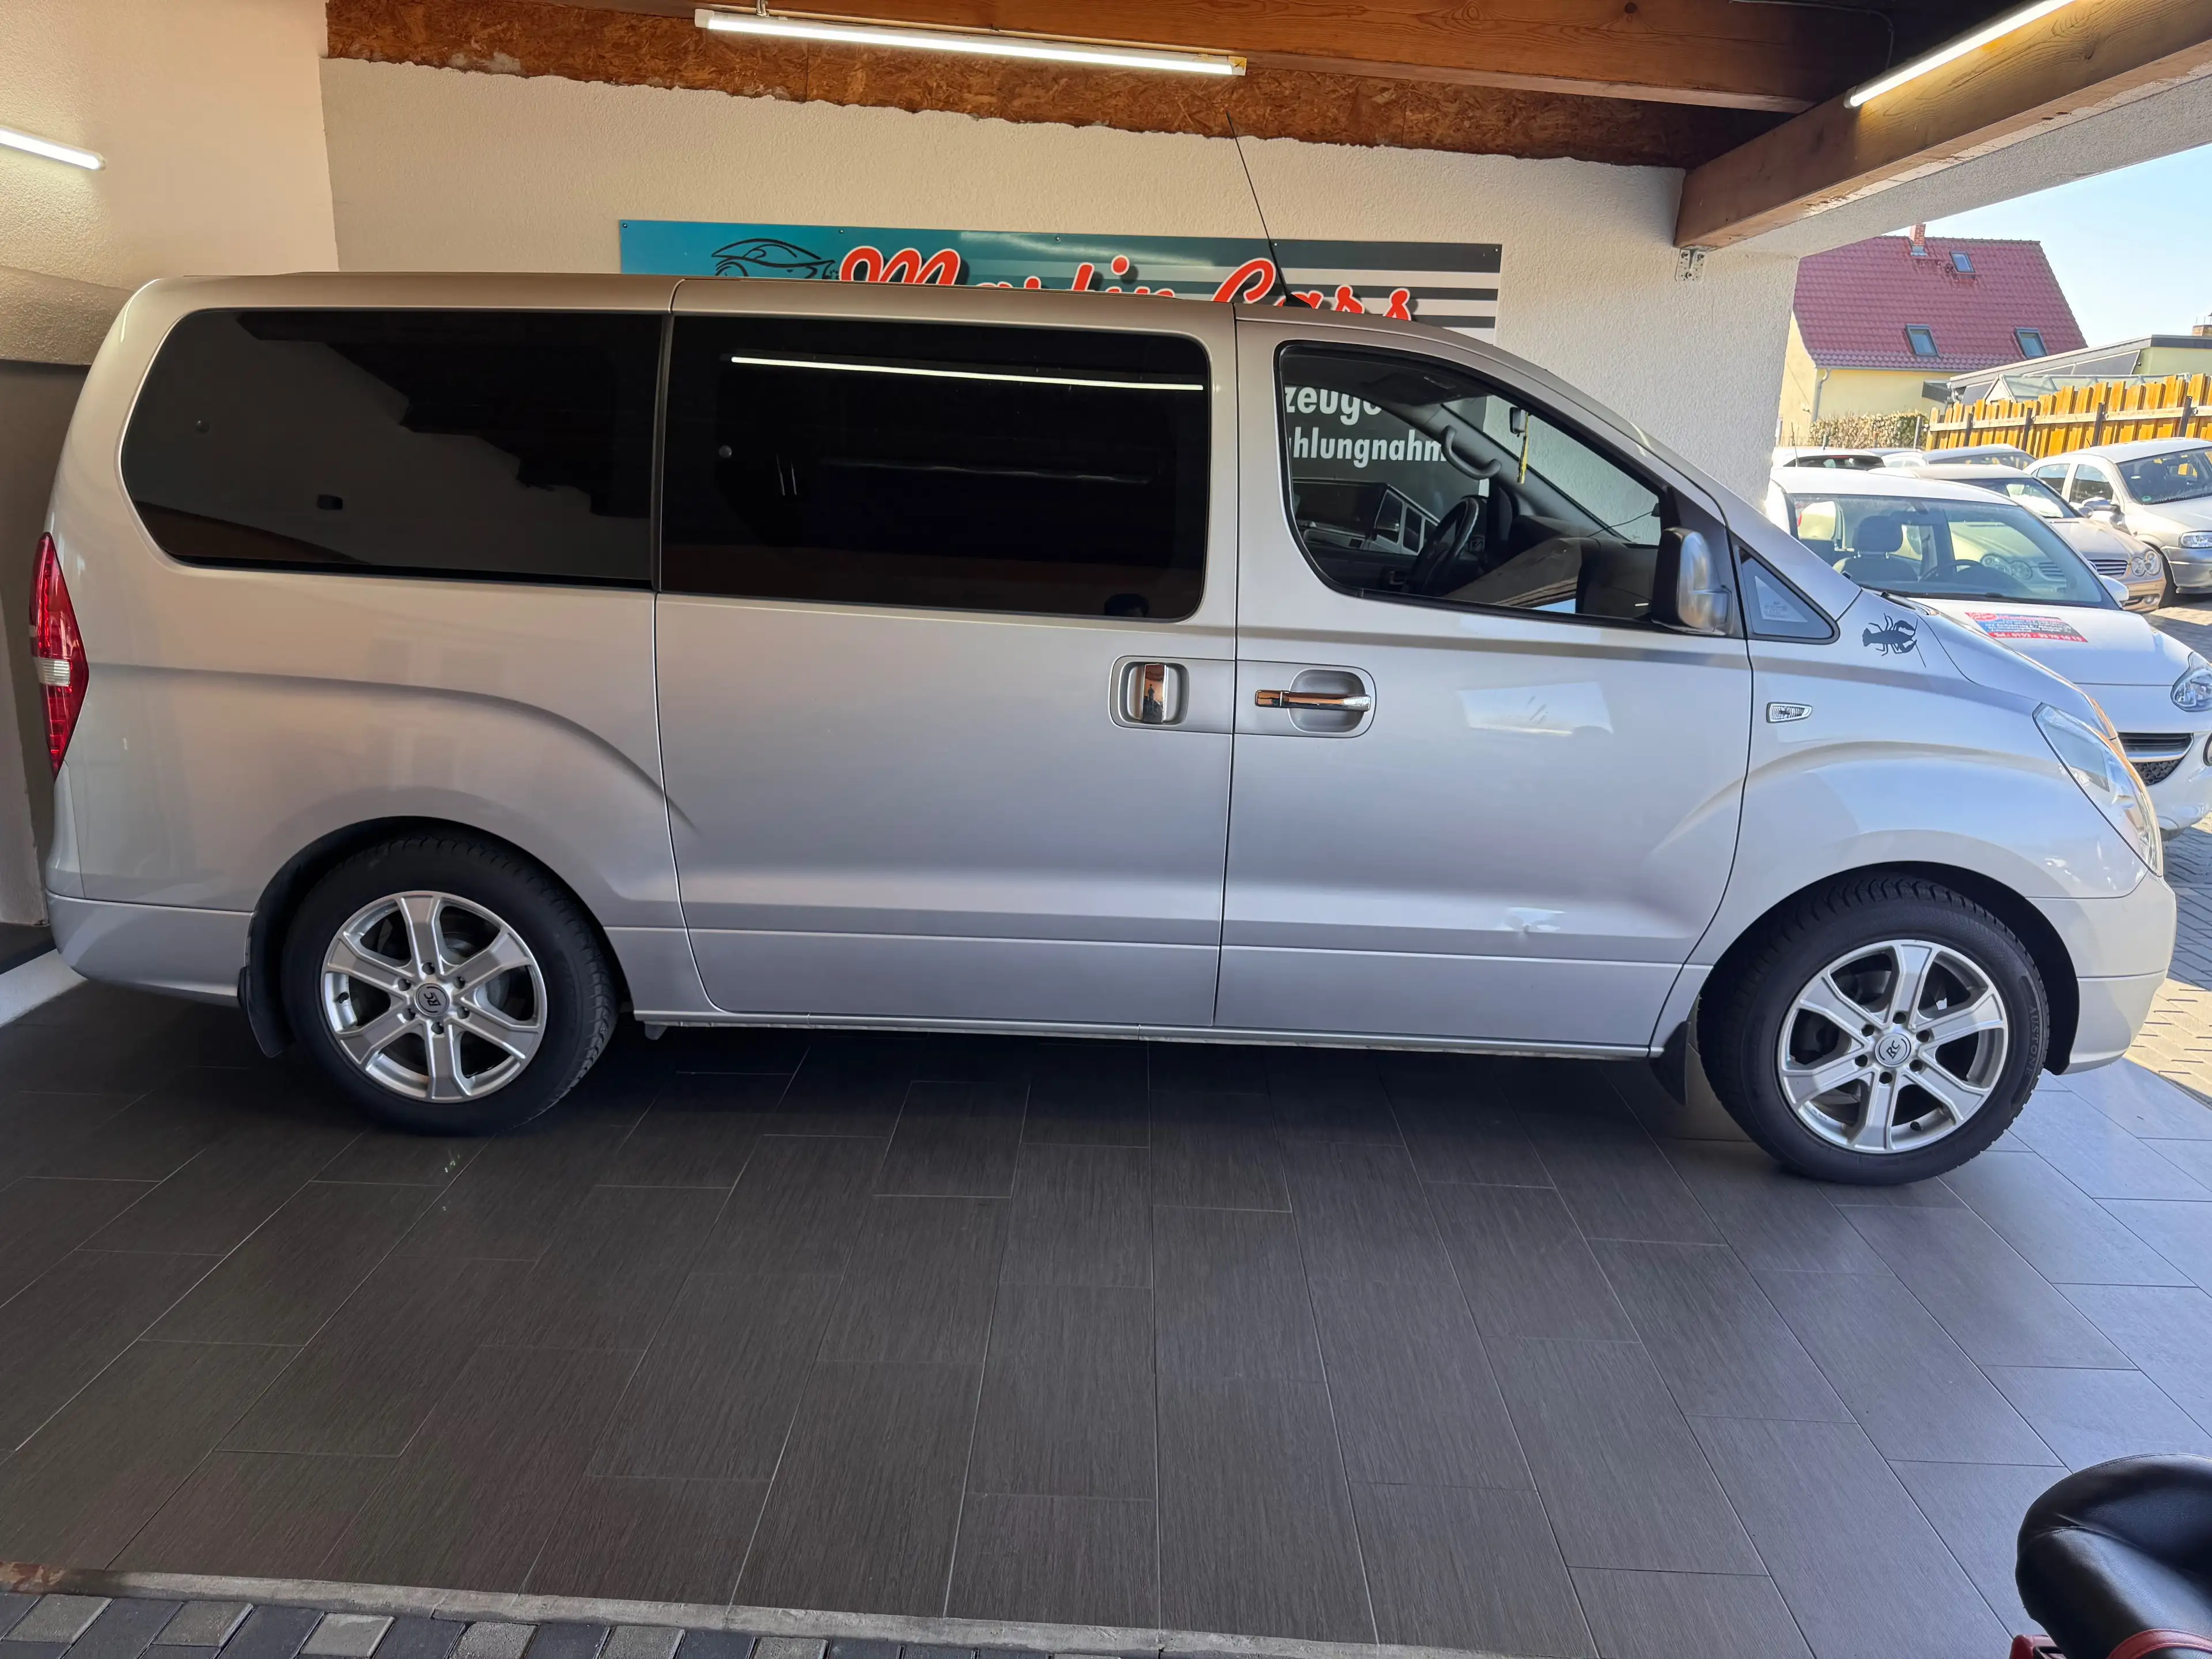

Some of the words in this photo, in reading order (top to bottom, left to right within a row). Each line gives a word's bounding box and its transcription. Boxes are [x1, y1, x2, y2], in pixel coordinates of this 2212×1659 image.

[1288, 426, 1447, 468] hlungnahm
[1886, 1040, 1901, 1059] RC
[2024, 1005, 2040, 1076] AUSTONE
